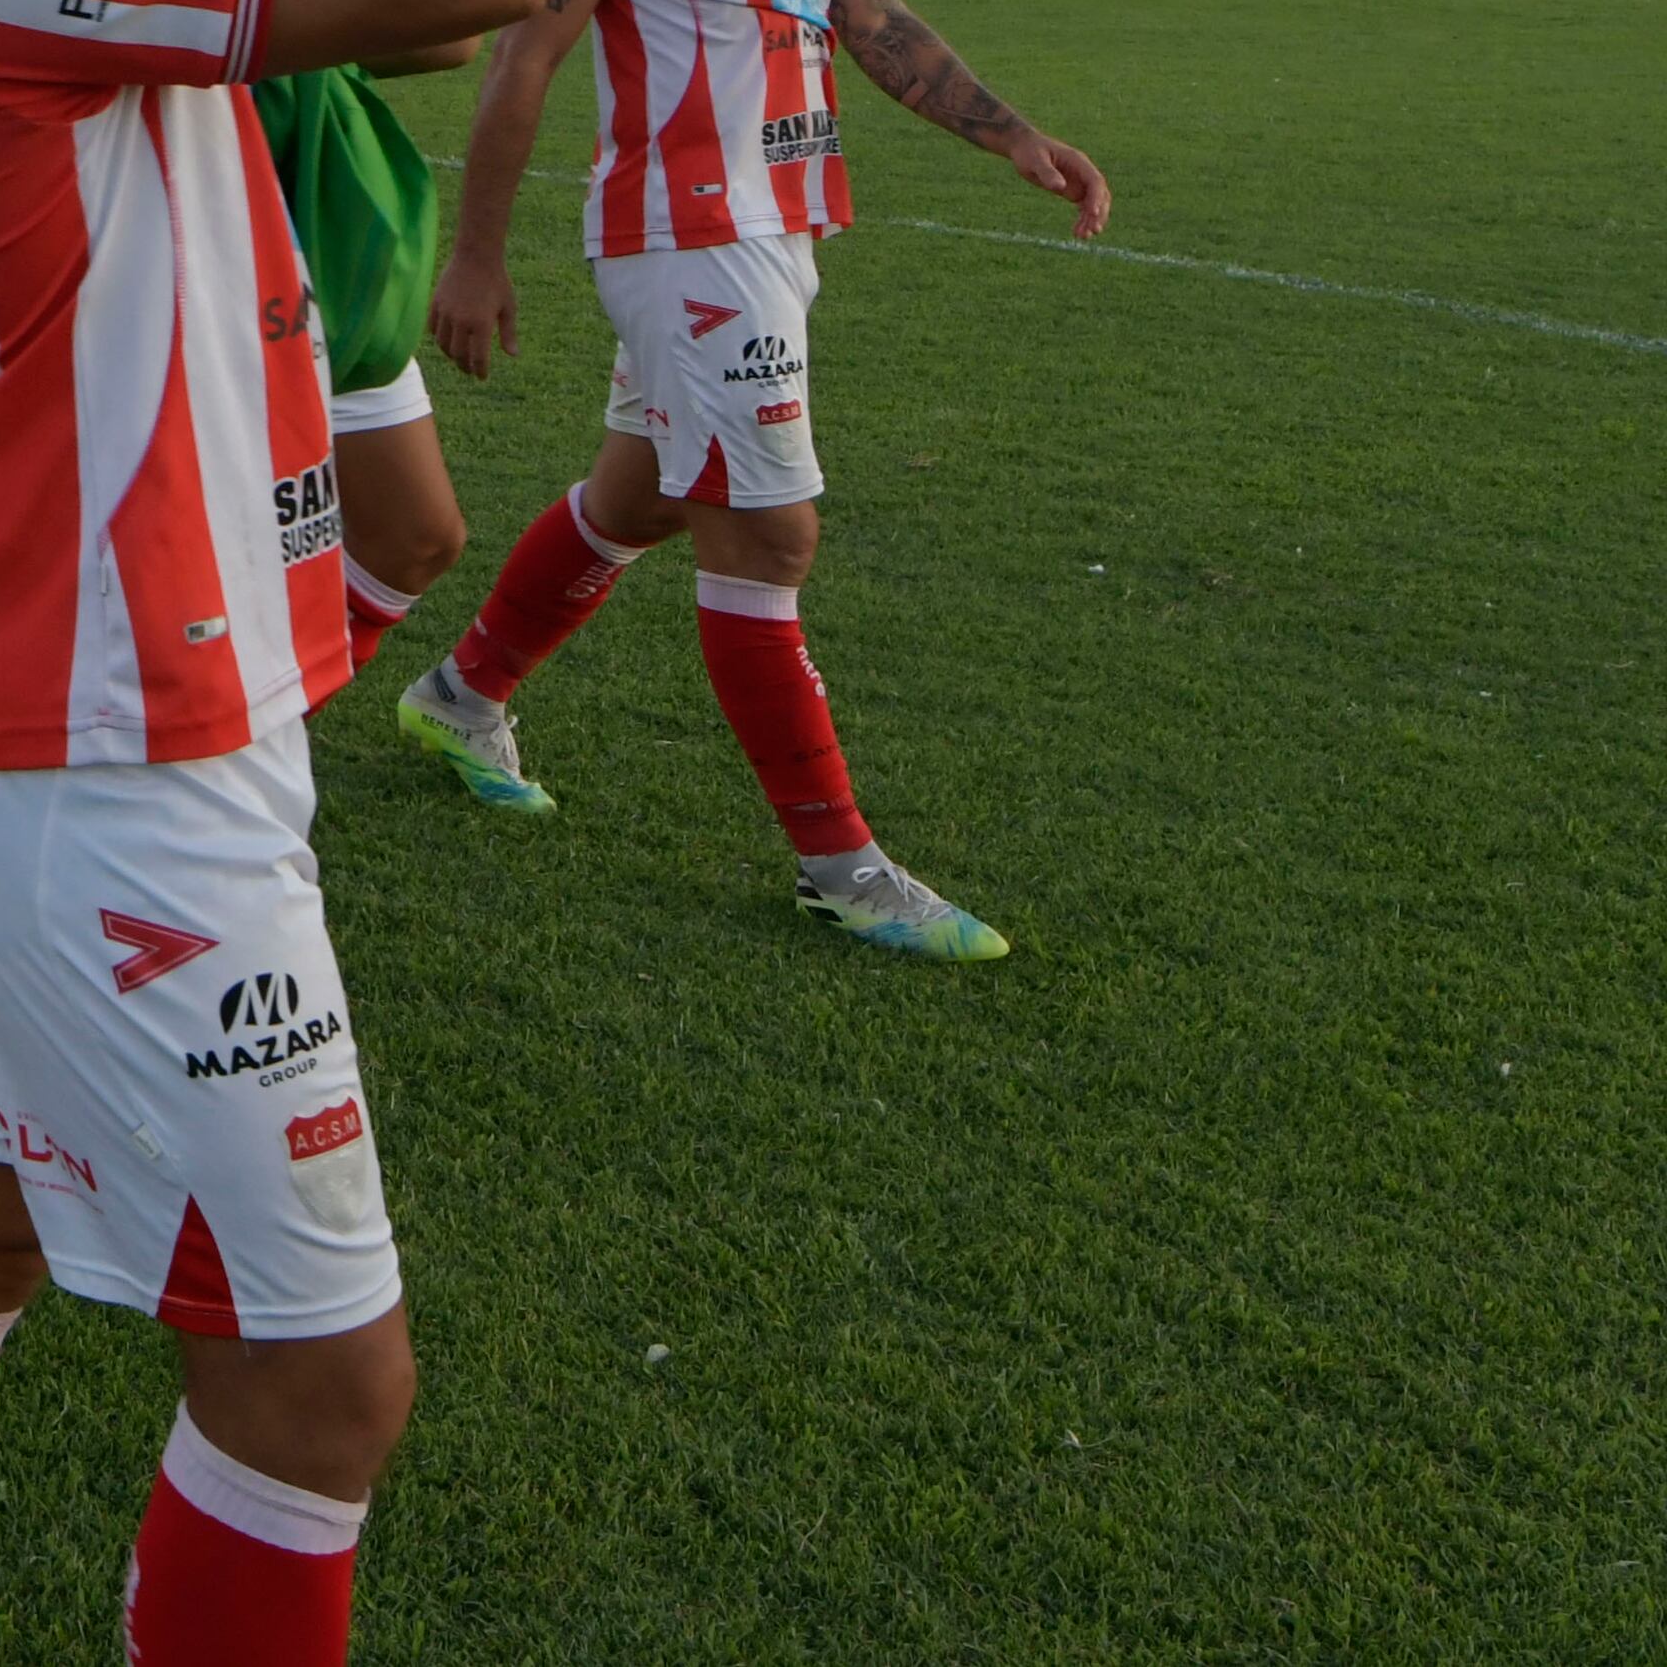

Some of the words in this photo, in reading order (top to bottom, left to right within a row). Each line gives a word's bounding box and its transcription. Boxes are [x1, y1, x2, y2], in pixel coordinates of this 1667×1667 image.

[761, 114, 808, 146] SAN
[723, 358, 804, 383] MAZARA
[185, 1010, 342, 1079] MAZARA
[258, 1057, 318, 1089] GROUP
